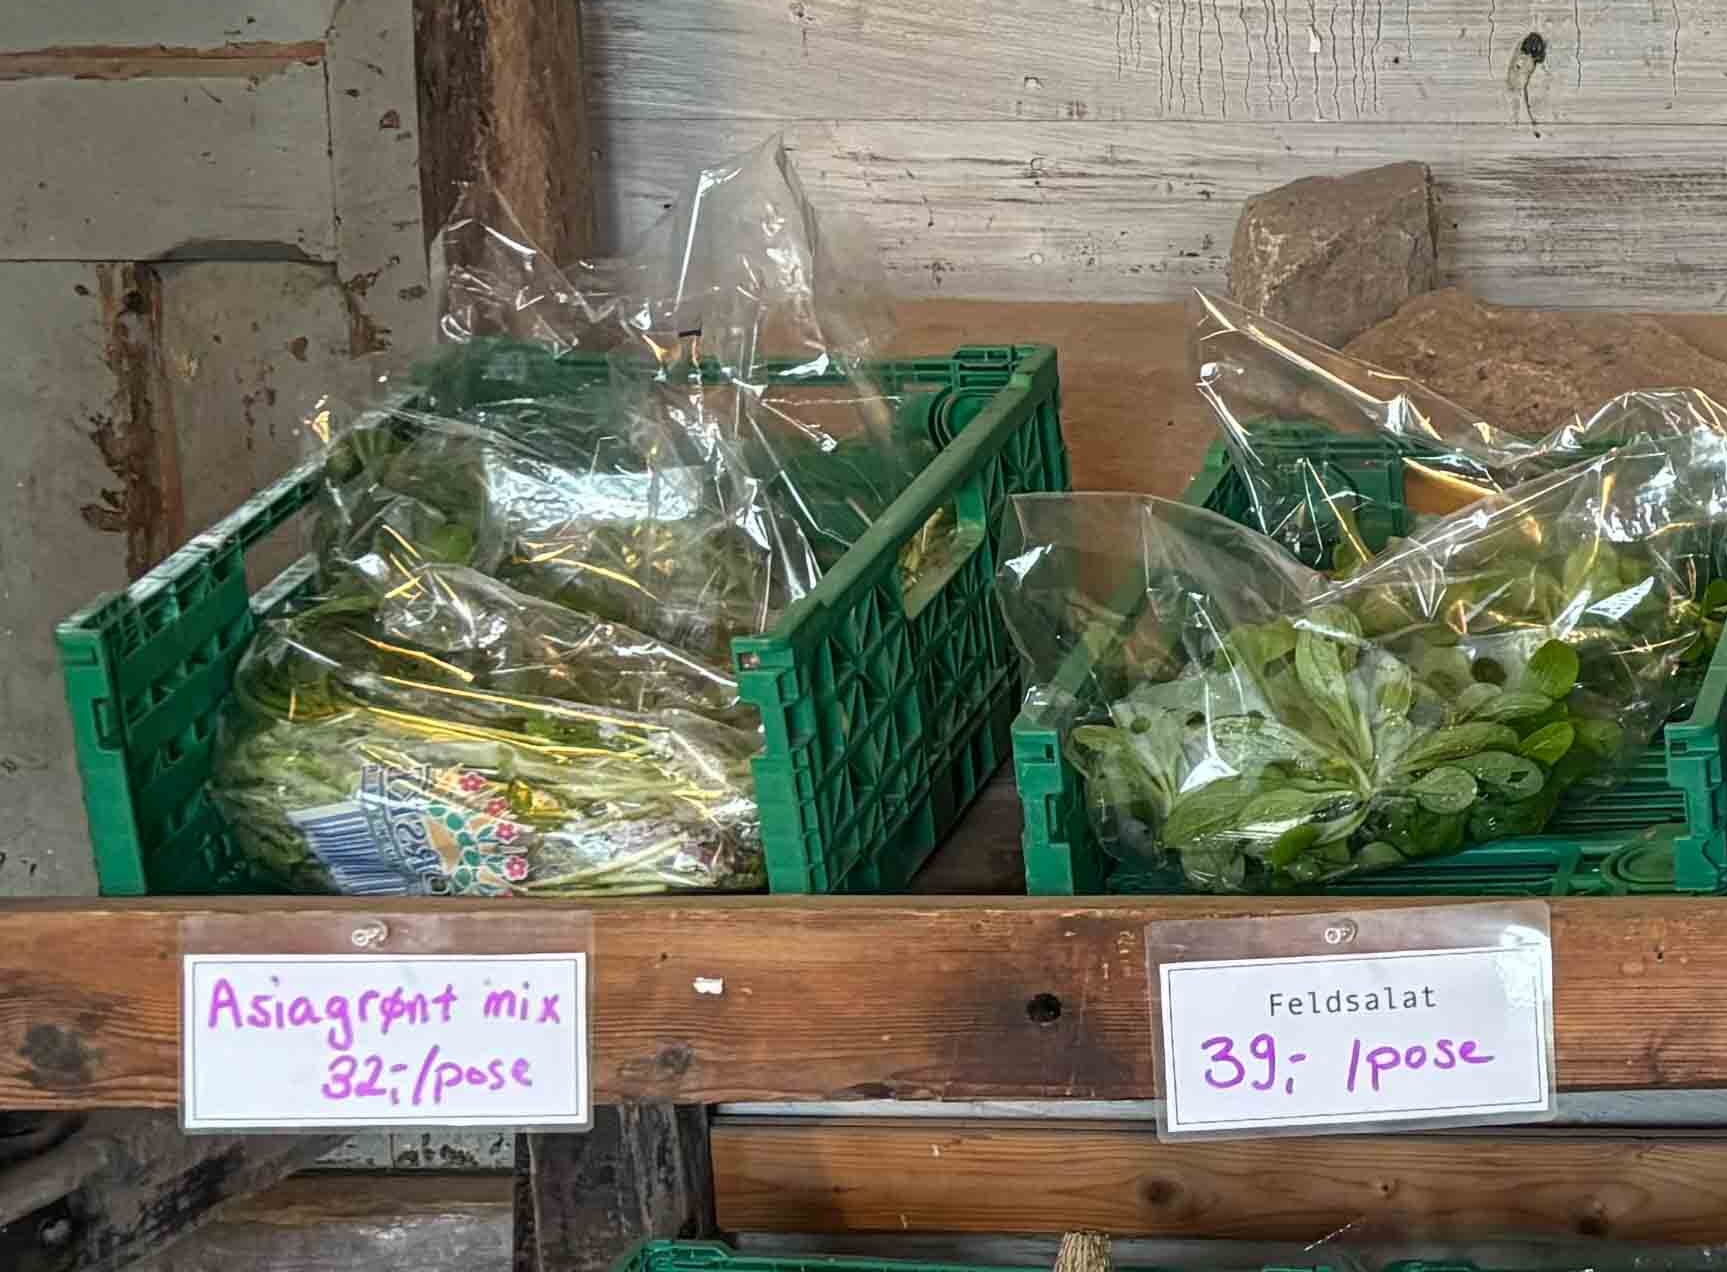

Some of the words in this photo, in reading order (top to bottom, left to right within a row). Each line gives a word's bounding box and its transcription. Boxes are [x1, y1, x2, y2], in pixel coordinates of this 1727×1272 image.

[207, 975, 458, 1051] Asiagrønt
[483, 980, 562, 1025] mix
[1269, 984, 1439, 1018] Feldsalat
